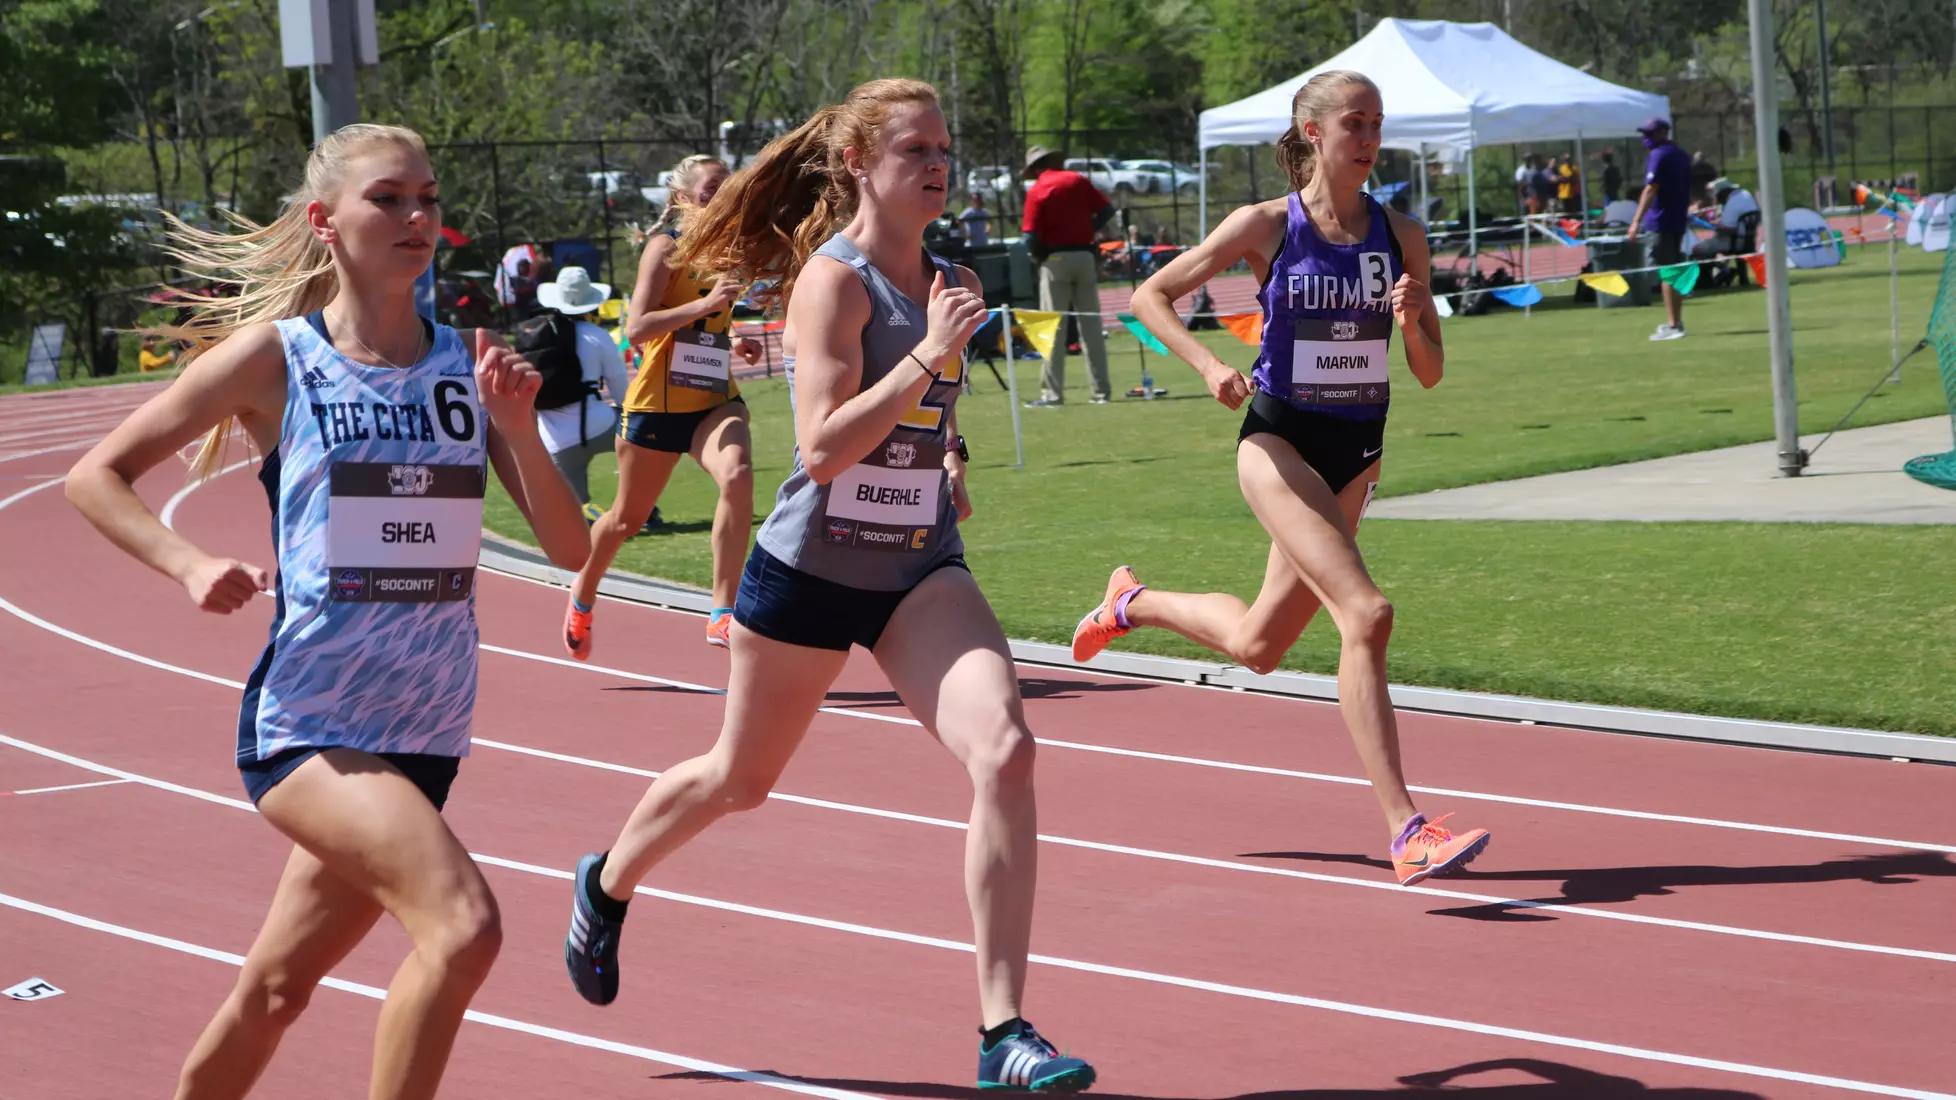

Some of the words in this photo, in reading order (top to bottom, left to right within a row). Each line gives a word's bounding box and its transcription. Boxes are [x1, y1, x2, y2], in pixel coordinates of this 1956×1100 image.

[1368, 254, 1387, 299] 3
[1288, 274, 1391, 314] FURM
[1316, 355, 1369, 370] MARVIN
[300, 378, 336, 389] adidas
[1320, 389, 1358, 399] #SOCONTF
[433, 379, 475, 442] 6
[311, 402, 369, 451] THE
[856, 483, 921, 506] BUERHLE
[381, 522, 436, 544] SHEA
[859, 530, 906, 544] #SOCONTF
[911, 529, 927, 548] C
[375, 579, 435, 591] #SOCONTF
[12, 983, 55, 998] 5
